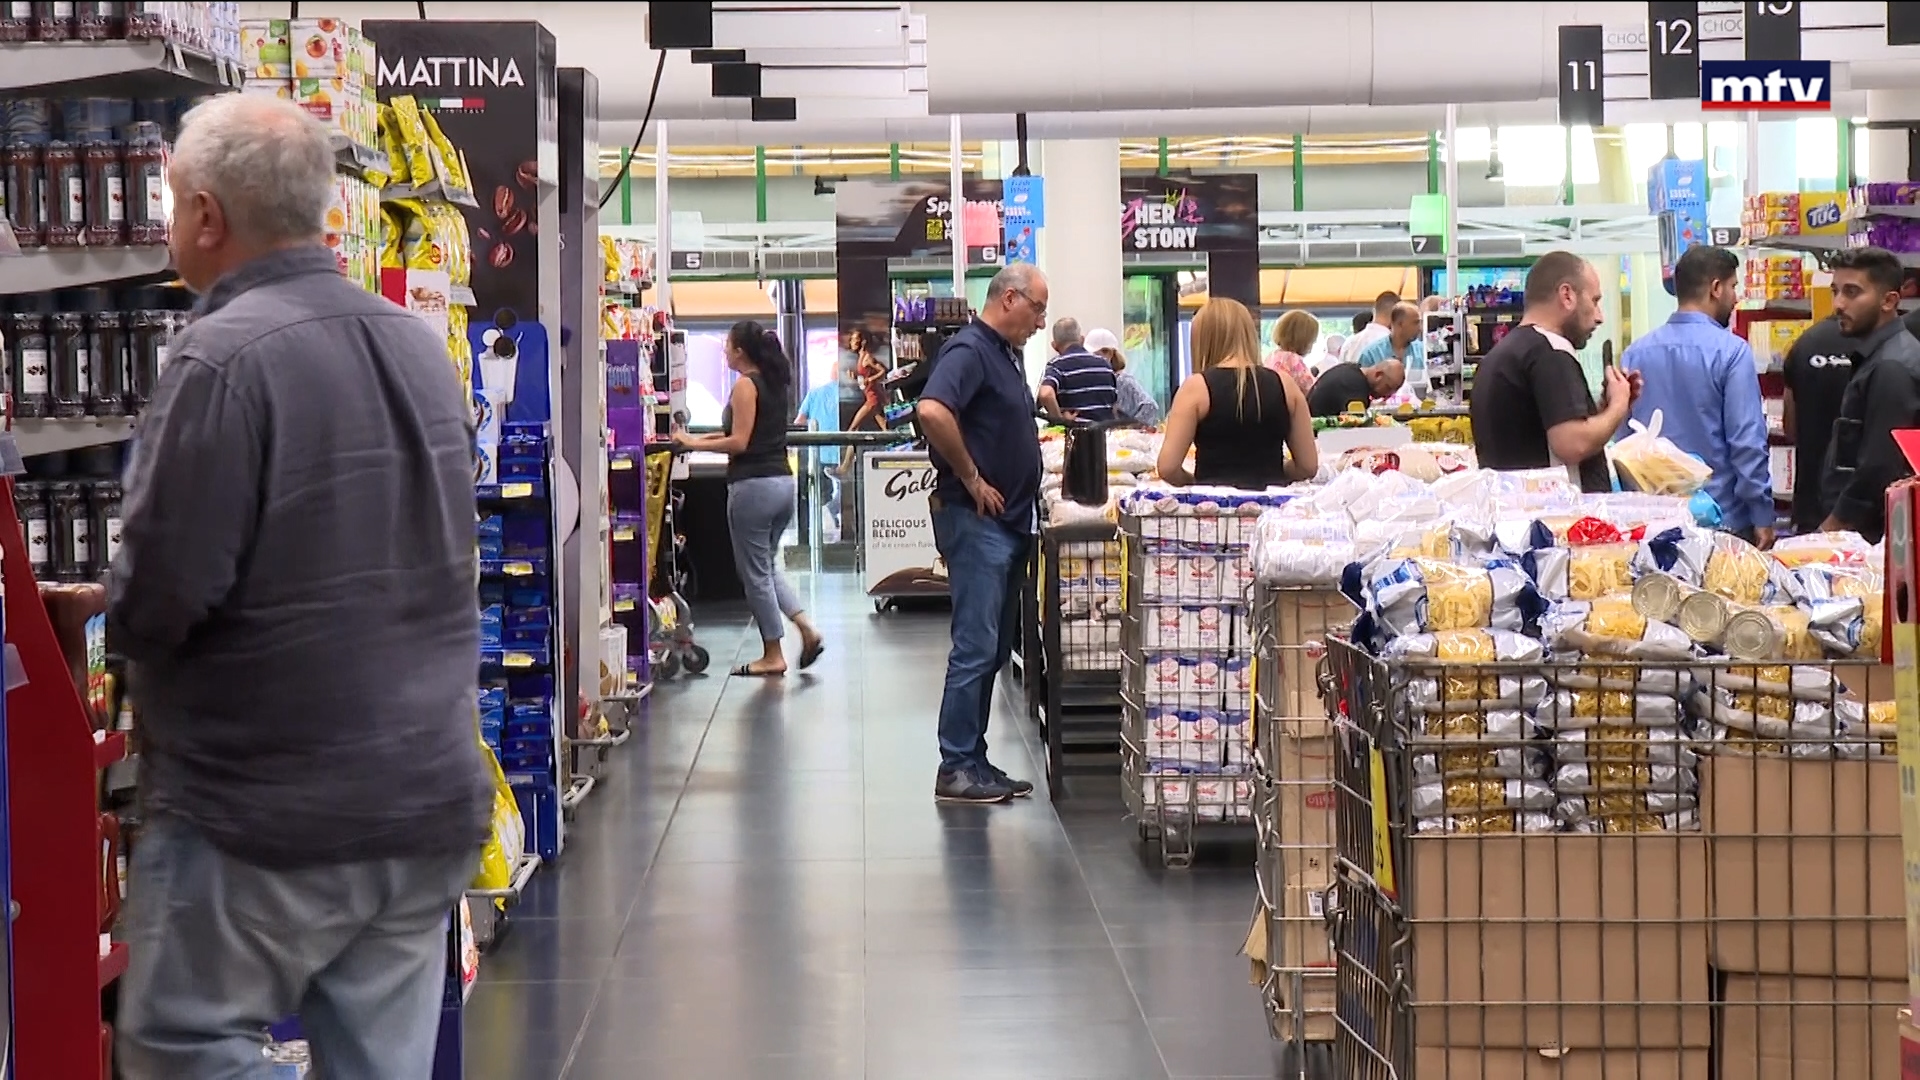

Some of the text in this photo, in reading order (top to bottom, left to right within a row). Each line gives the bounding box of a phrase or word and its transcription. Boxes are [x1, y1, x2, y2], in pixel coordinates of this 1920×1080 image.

[1655, 19, 1693, 55] 12
[377, 56, 525, 87] MATTINA
[1567, 61, 1596, 91] 11
[1135, 203, 1176, 224] HER
[1134, 227, 1198, 248] STORY
[1413, 237, 1427, 252] 7
[1715, 230, 1730, 244] 8
[686, 253, 700, 268] 5
[872, 519, 927, 528] DELICIOUS
